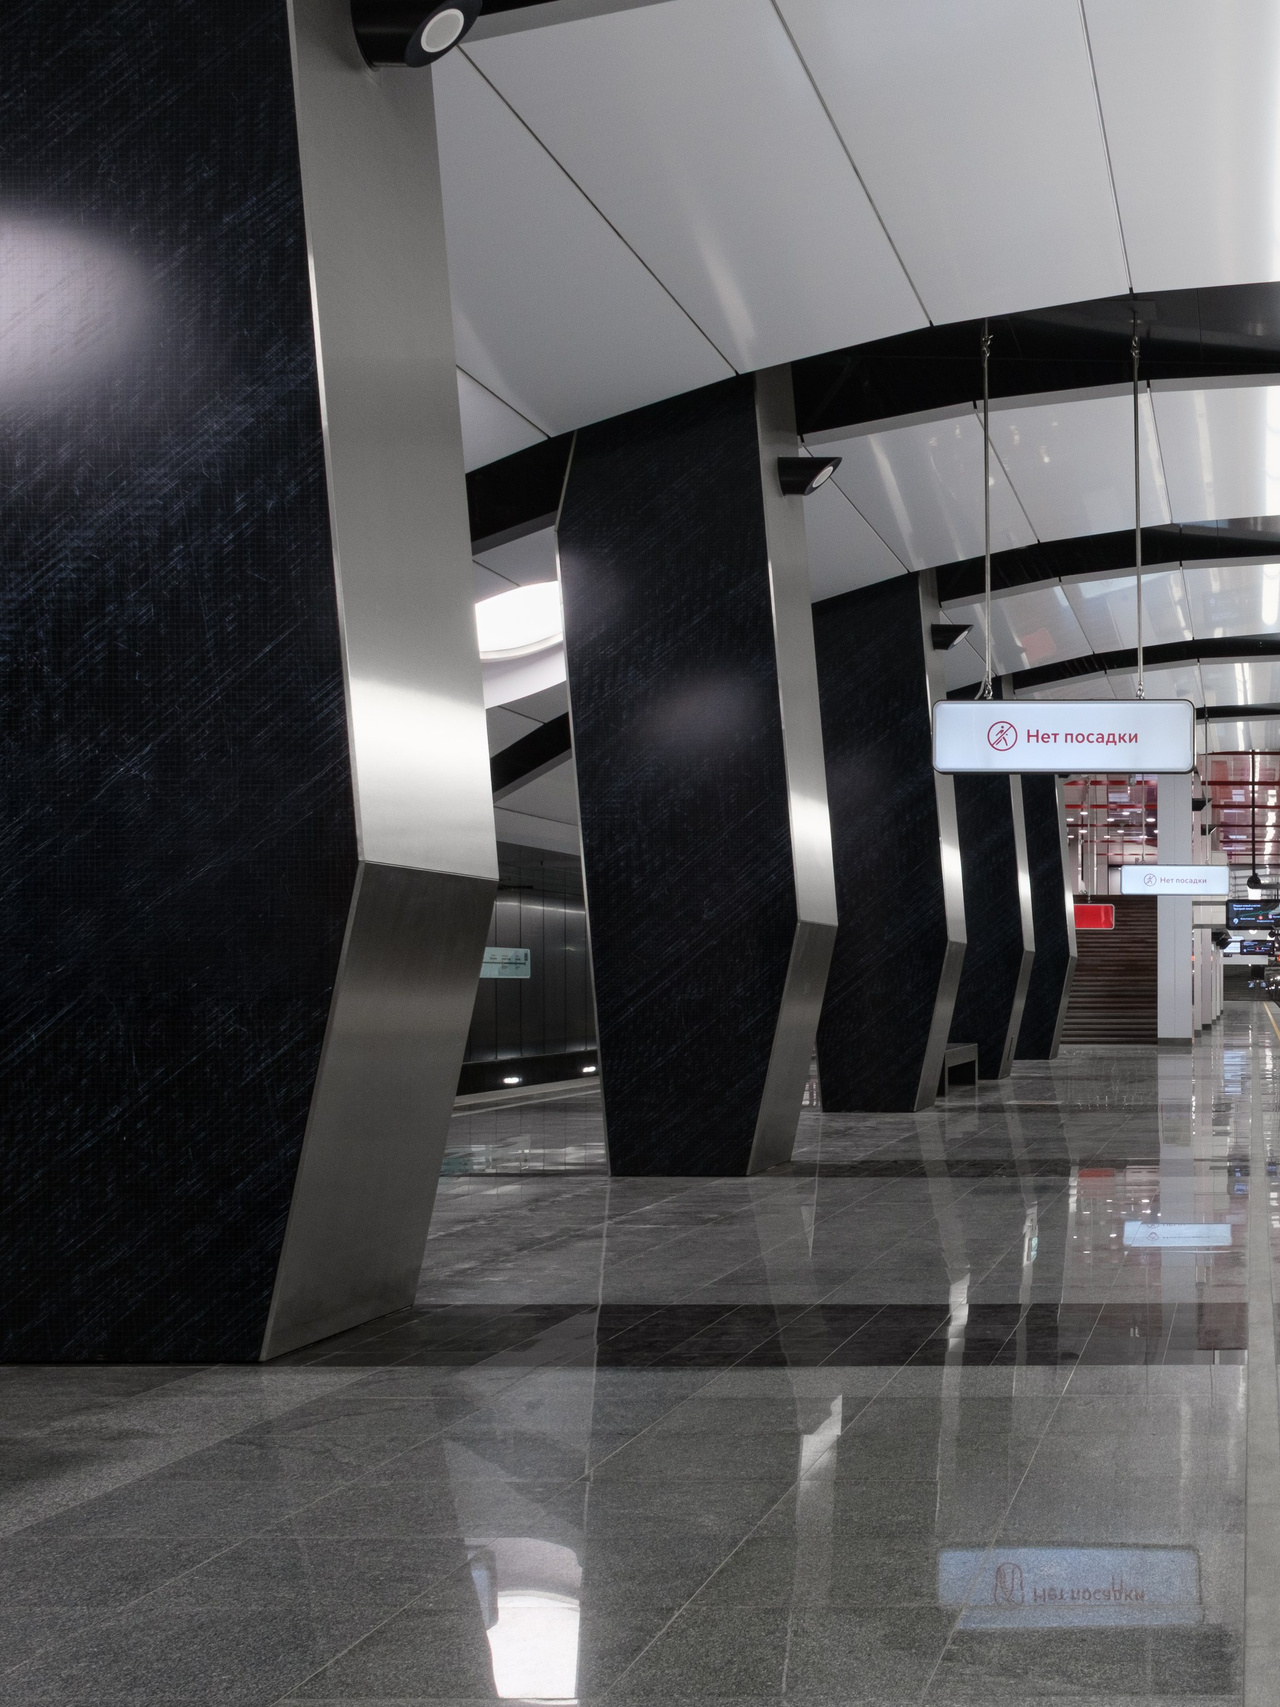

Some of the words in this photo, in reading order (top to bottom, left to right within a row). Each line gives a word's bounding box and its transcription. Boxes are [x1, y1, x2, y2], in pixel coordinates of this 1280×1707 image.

[1027, 729, 1060, 744] Нет
[1064, 732, 1138, 746] посадки
[1175, 877, 1207, 885] посадки
